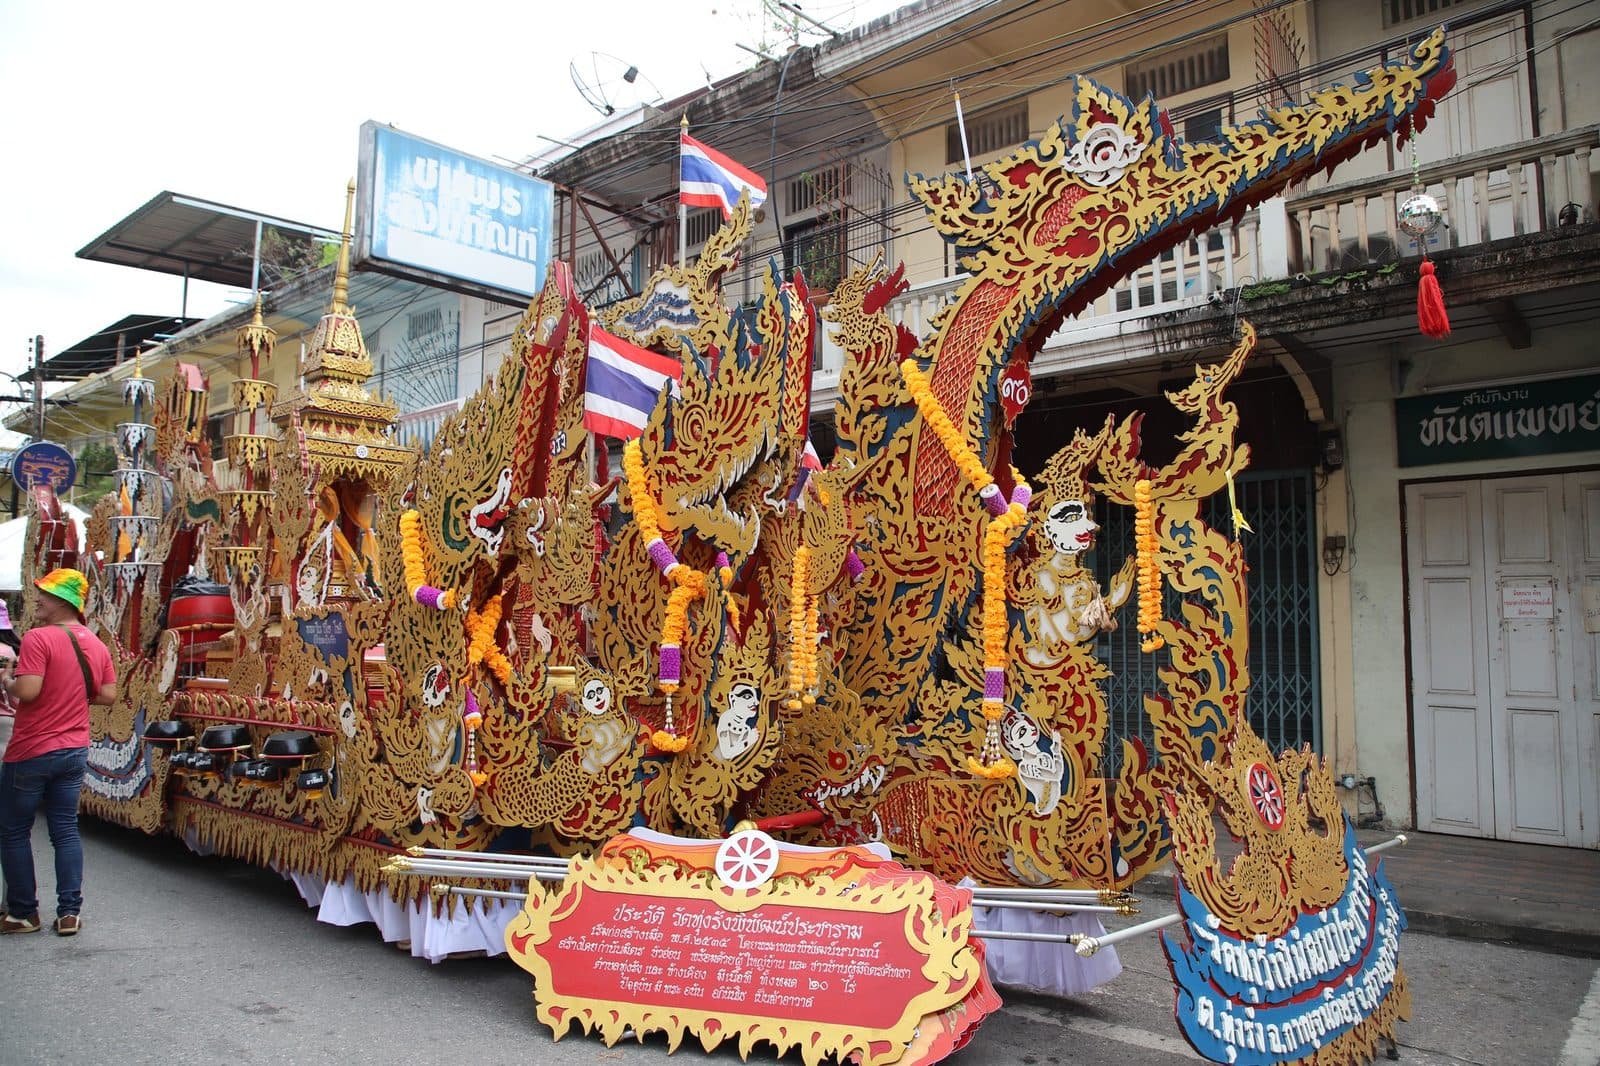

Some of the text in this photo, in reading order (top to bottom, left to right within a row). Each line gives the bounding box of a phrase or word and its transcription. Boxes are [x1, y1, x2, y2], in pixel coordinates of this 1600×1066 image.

[1462, 389, 1529, 406] สำนักงาน
[613, 903, 665, 925] ประวัติ
[671, 933, 731, 949] พ.ศ.๒๕๓๕
[789, 960, 807, 971] และ
[645, 963, 663, 977] และ
[808, 977, 829, 992] ๒๐
[841, 978, 857, 994] ไร่
